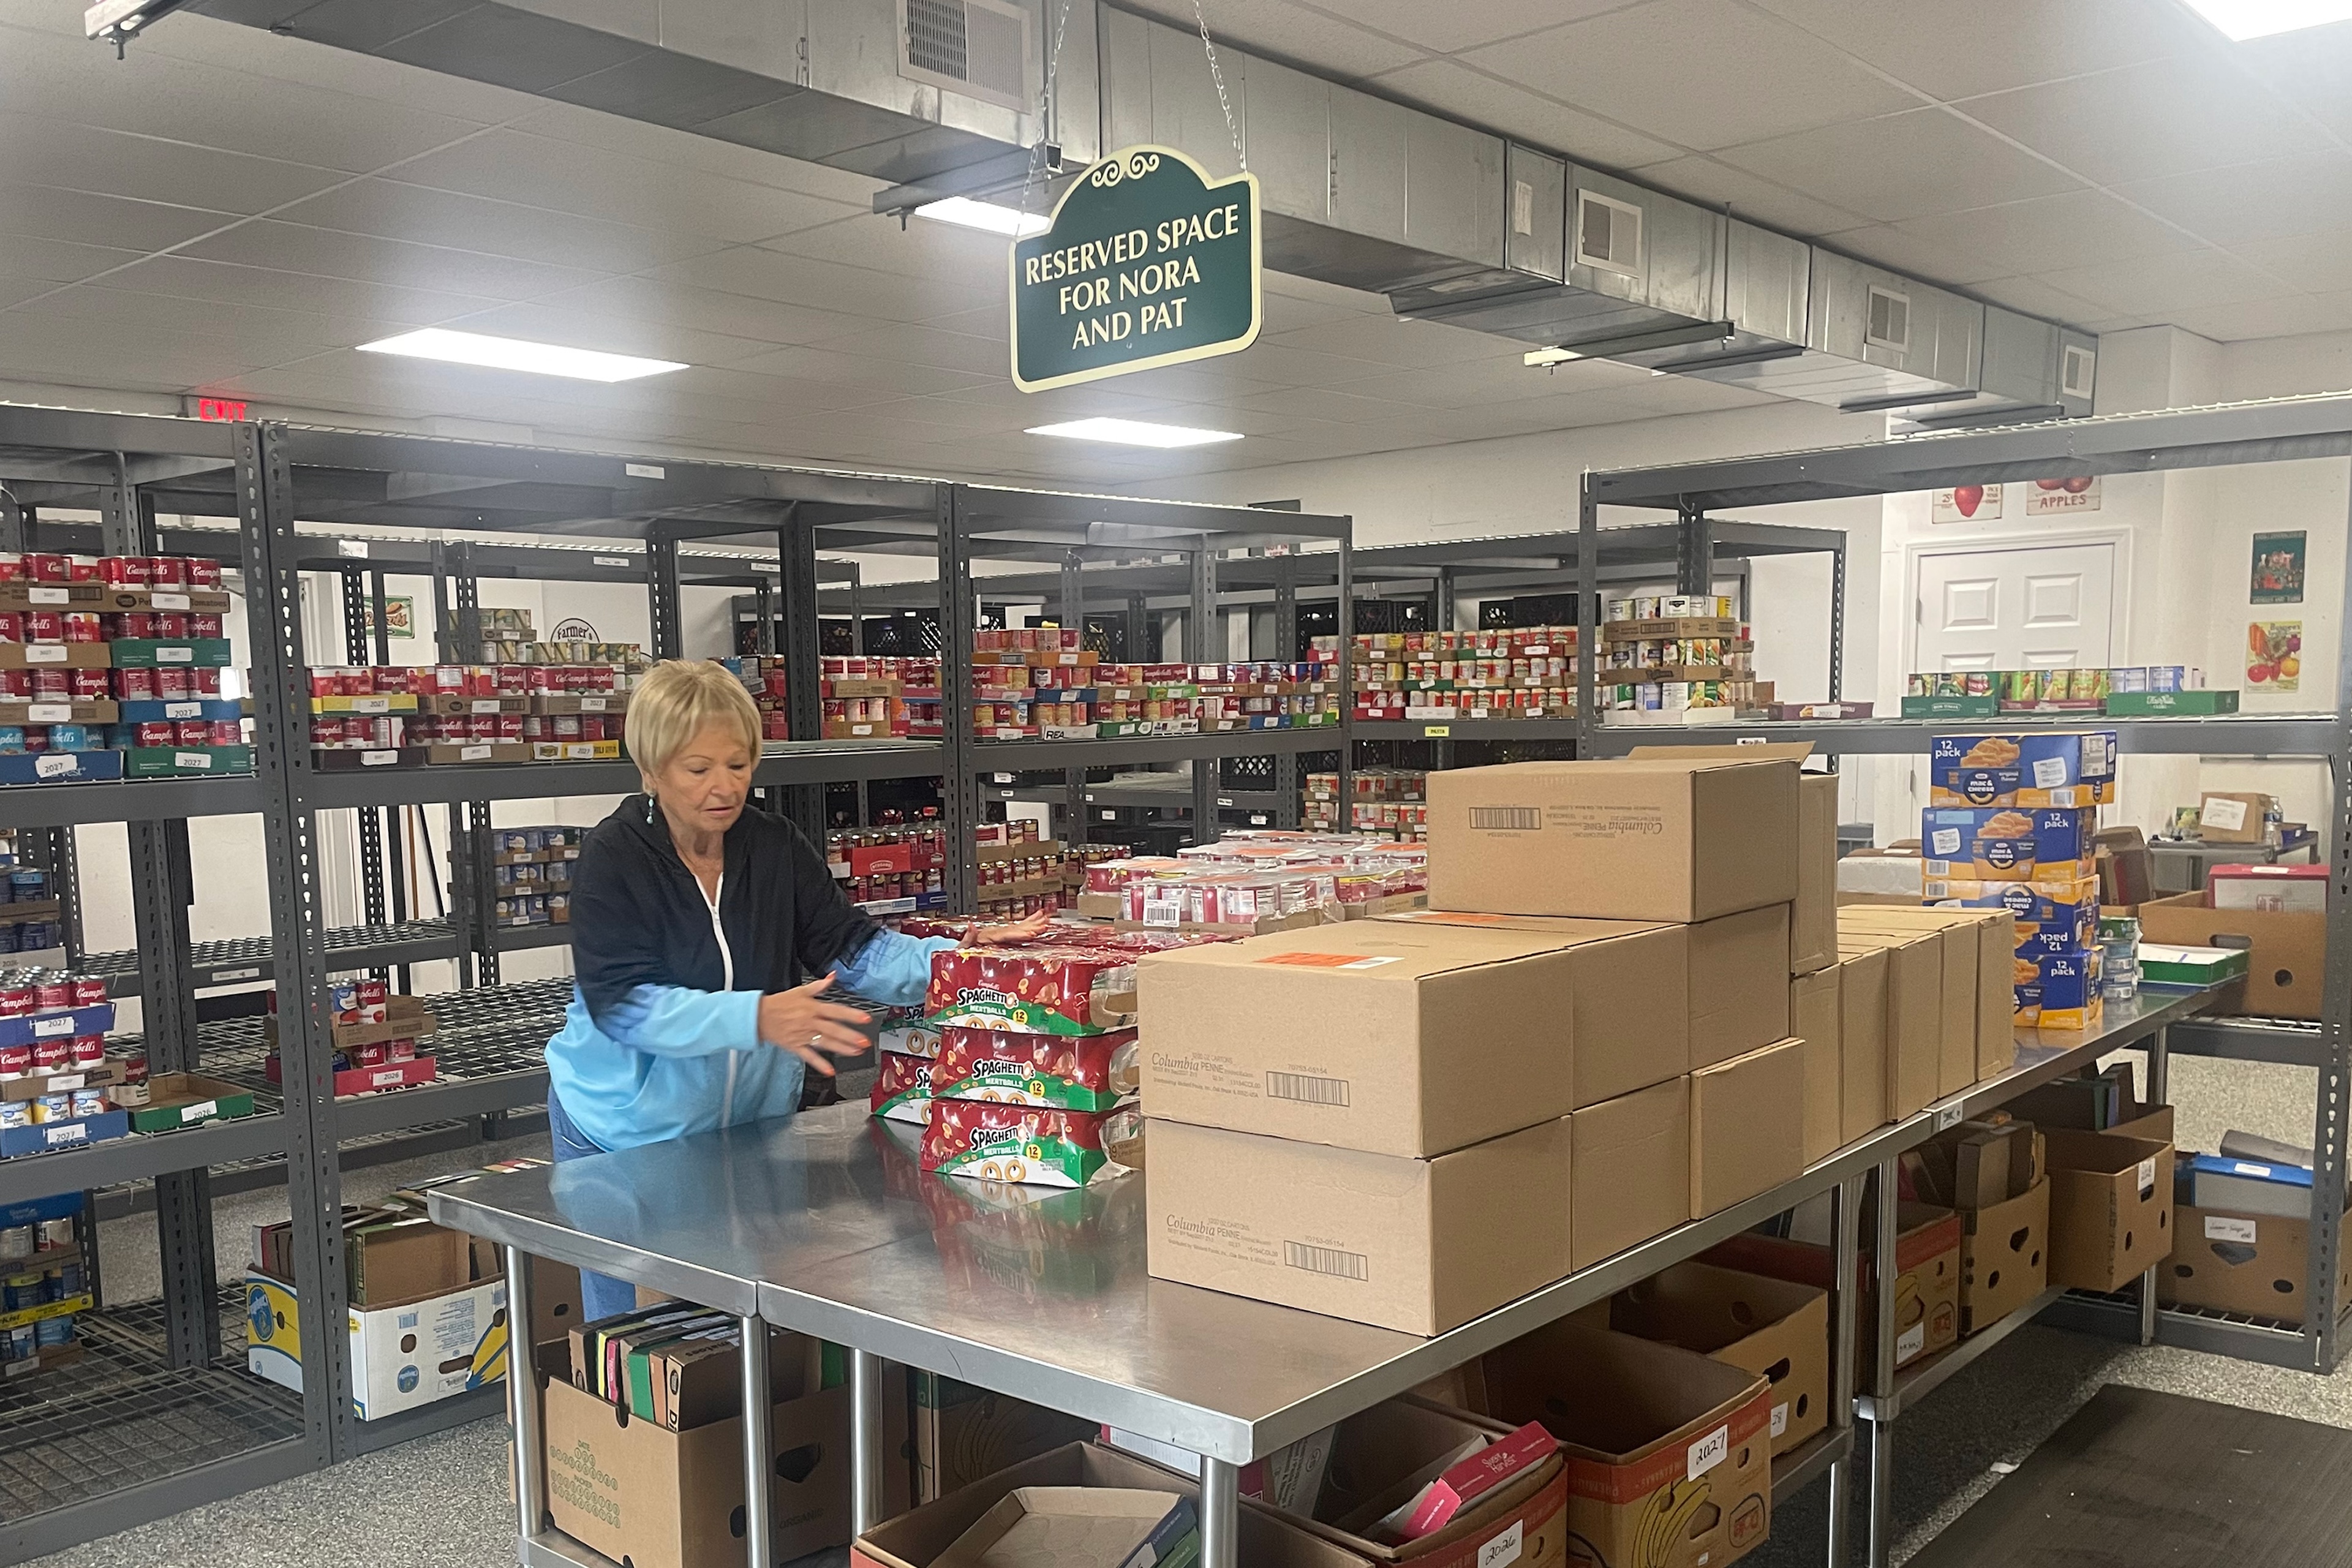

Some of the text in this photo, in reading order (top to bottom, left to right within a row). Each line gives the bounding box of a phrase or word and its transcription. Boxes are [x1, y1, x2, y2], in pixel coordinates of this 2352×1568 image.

[1025, 204, 1239, 286] RESERVED SPACE
[1060, 256, 1201, 315] FOR NORA
[1072, 298, 1187, 350] AND PAT
[2040, 494, 2087, 509] APPLES
[557, 626, 594, 641] Farmer's
[175, 709, 193, 718] 2027
[1940, 740, 1953, 750] 12
[1936, 747, 1961, 760] pack
[45, 763, 64, 773] 2027
[2049, 813, 2060, 821] 12
[1583, 821, 1663, 834] Columbia PENNE
[2045, 818, 2069, 829] pack
[2039, 932, 2068, 944] pack
[2049, 941, 2062, 951] 12
[2056, 960, 2067, 969] 12
[2051, 967, 2076, 976] pack
[970, 1005, 1006, 1016] MEATBALLS
[1015, 1011, 1025, 1020] 12
[48, 1019, 67, 1028] 2027
[1152, 1052, 1199, 1071] Columbia
[1200, 1061, 1224, 1074] PENNE
[383, 1072, 399, 1080] 2026
[985, 1078, 1023, 1088] MEATBALLS
[1033, 1083, 1041, 1091] 12
[194, 1108, 212, 1119] 2026
[56, 1131, 75, 1141] 2027
[984, 1145, 1020, 1156] MEATBALLS
[1029, 1146, 1038, 1155] 12
[1167, 1214, 1241, 1240] Columbia PENNE
[1696, 1431, 1725, 1466] 2027
[1485, 1535, 1517, 1566] 2026
